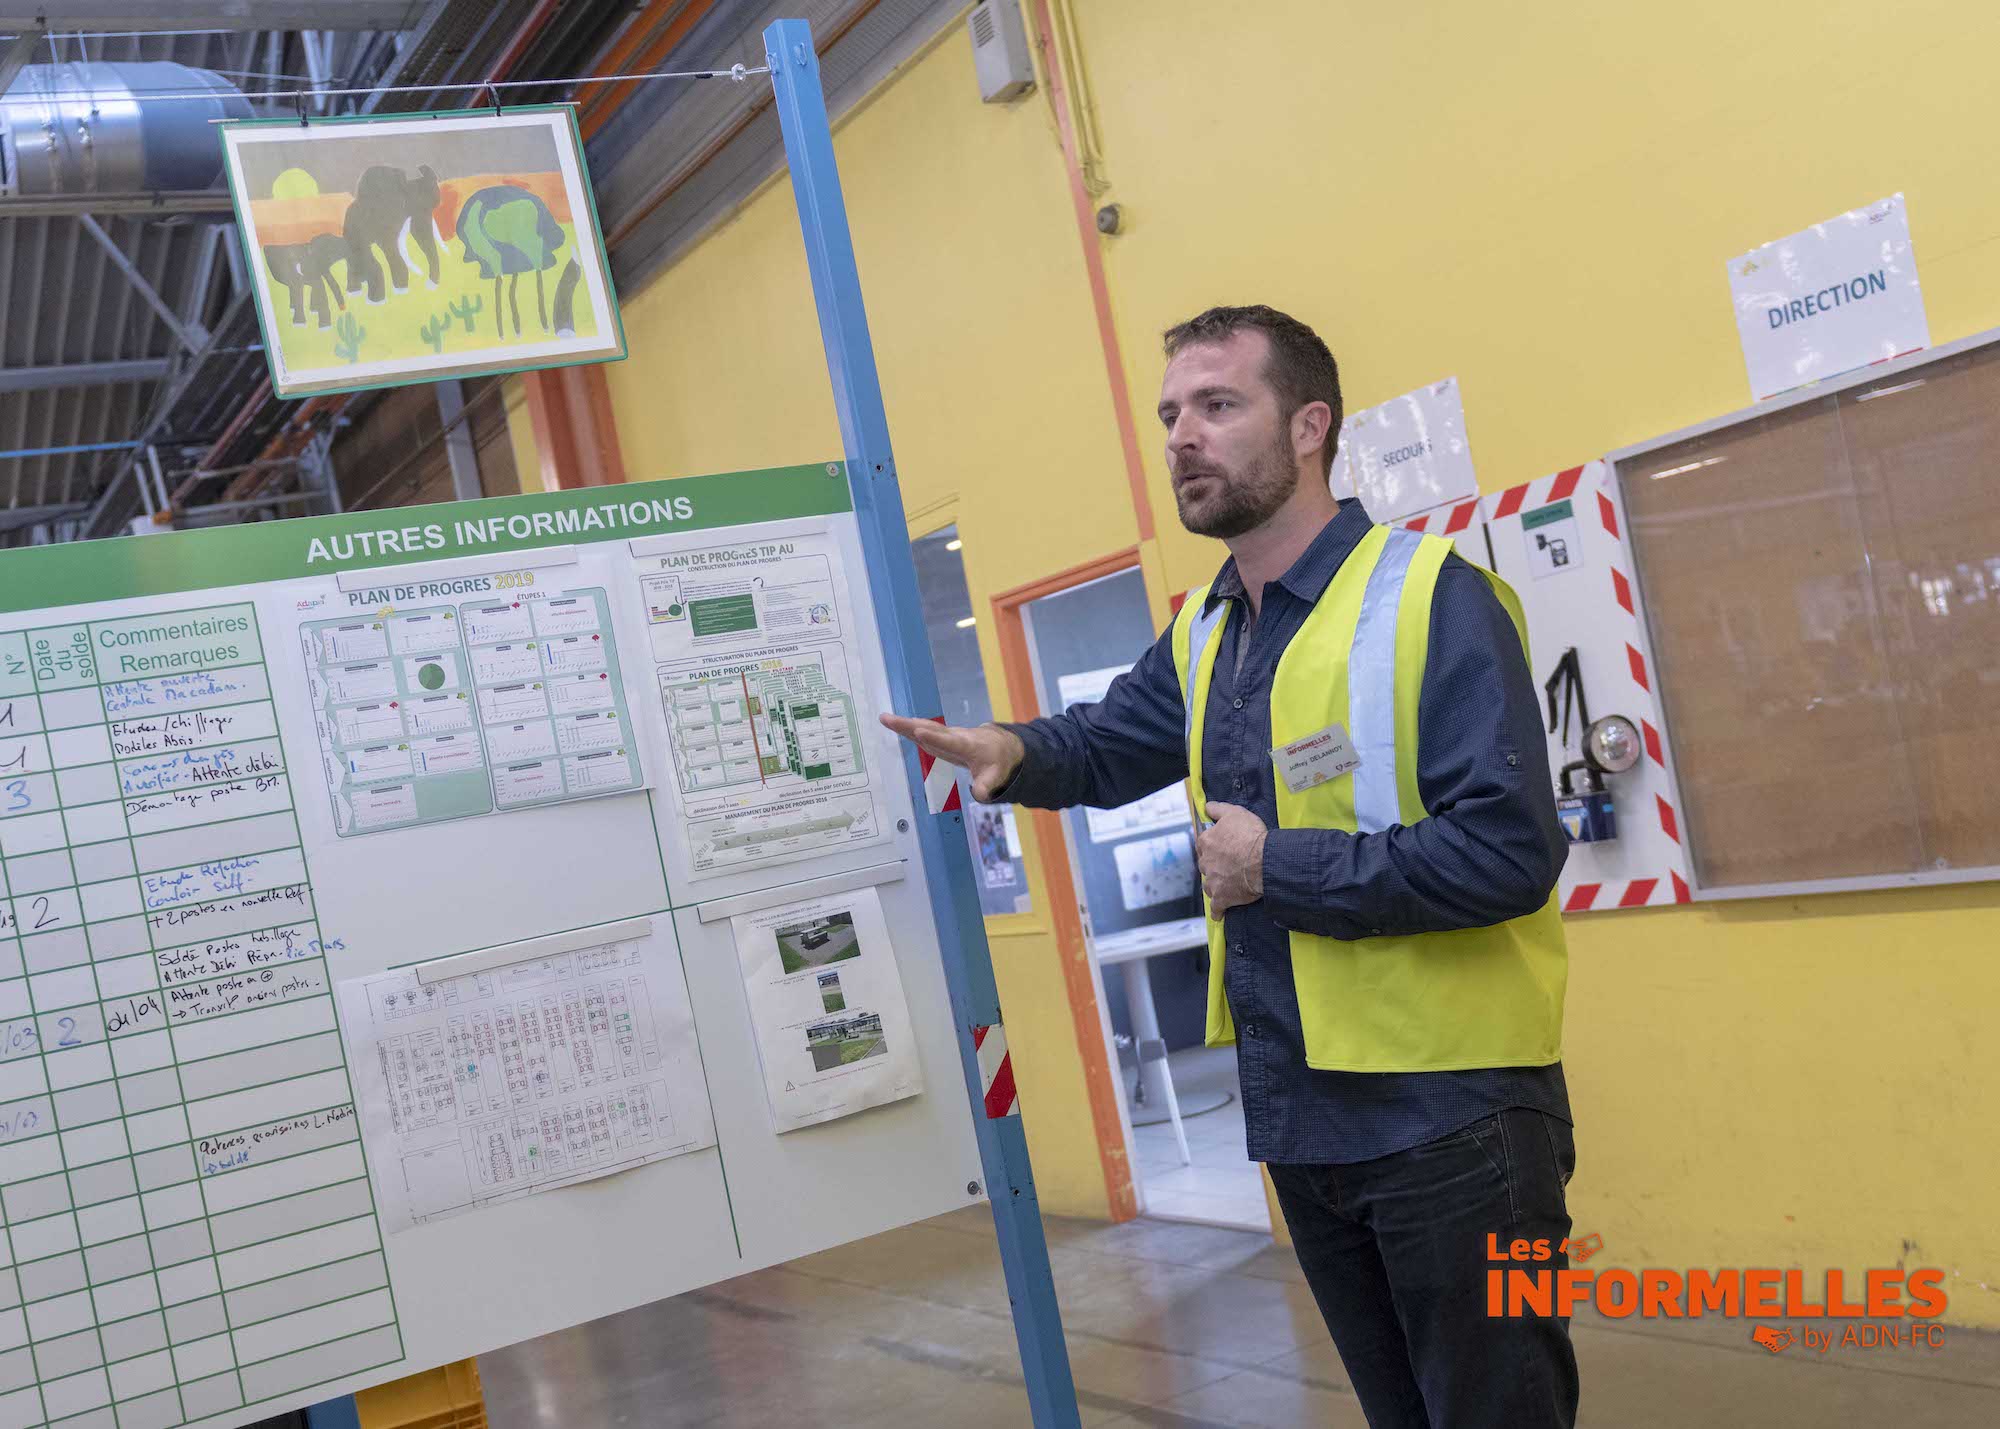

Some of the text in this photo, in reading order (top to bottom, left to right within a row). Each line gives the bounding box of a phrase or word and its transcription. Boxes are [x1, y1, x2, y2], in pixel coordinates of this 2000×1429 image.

[1767, 270, 1887, 329] DIRECTION
[306, 496, 694, 563] AUTRES INFORMATIONS
[661, 556, 689, 568] PLAN
[692, 553, 707, 565] DE
[759, 545, 776, 557] TIP
[779, 544, 794, 554] AU
[688, 563, 727, 572] CONSTRUCTION
[348, 571, 535, 606] PLAN DE PROGRES 2019
[99, 614, 249, 649] Commentaires
[5, 653, 26, 675] N°
[34, 639, 56, 681] Date
[55, 649, 73, 671] du
[71, 631, 94, 678] solde
[120, 643, 240, 674] Remarques
[702, 653, 744, 664] STRUCTURATION
[775, 645, 799, 653] PROGRES
[689, 672, 709, 680] PLAN
[711, 669, 722, 677] DE
[724, 663, 760, 675] PROGRES
[1287, 734, 1332, 757] INFORMELLES
[192, 761, 242, 782] Attente
[6, 780, 32, 812] 3
[211, 781, 247, 802] poste
[724, 809, 762, 820] MANAGEMENT
[771, 804, 785, 812] PLAN
[32, 896, 60, 929] 2
[58, 1017, 82, 1046] 2
